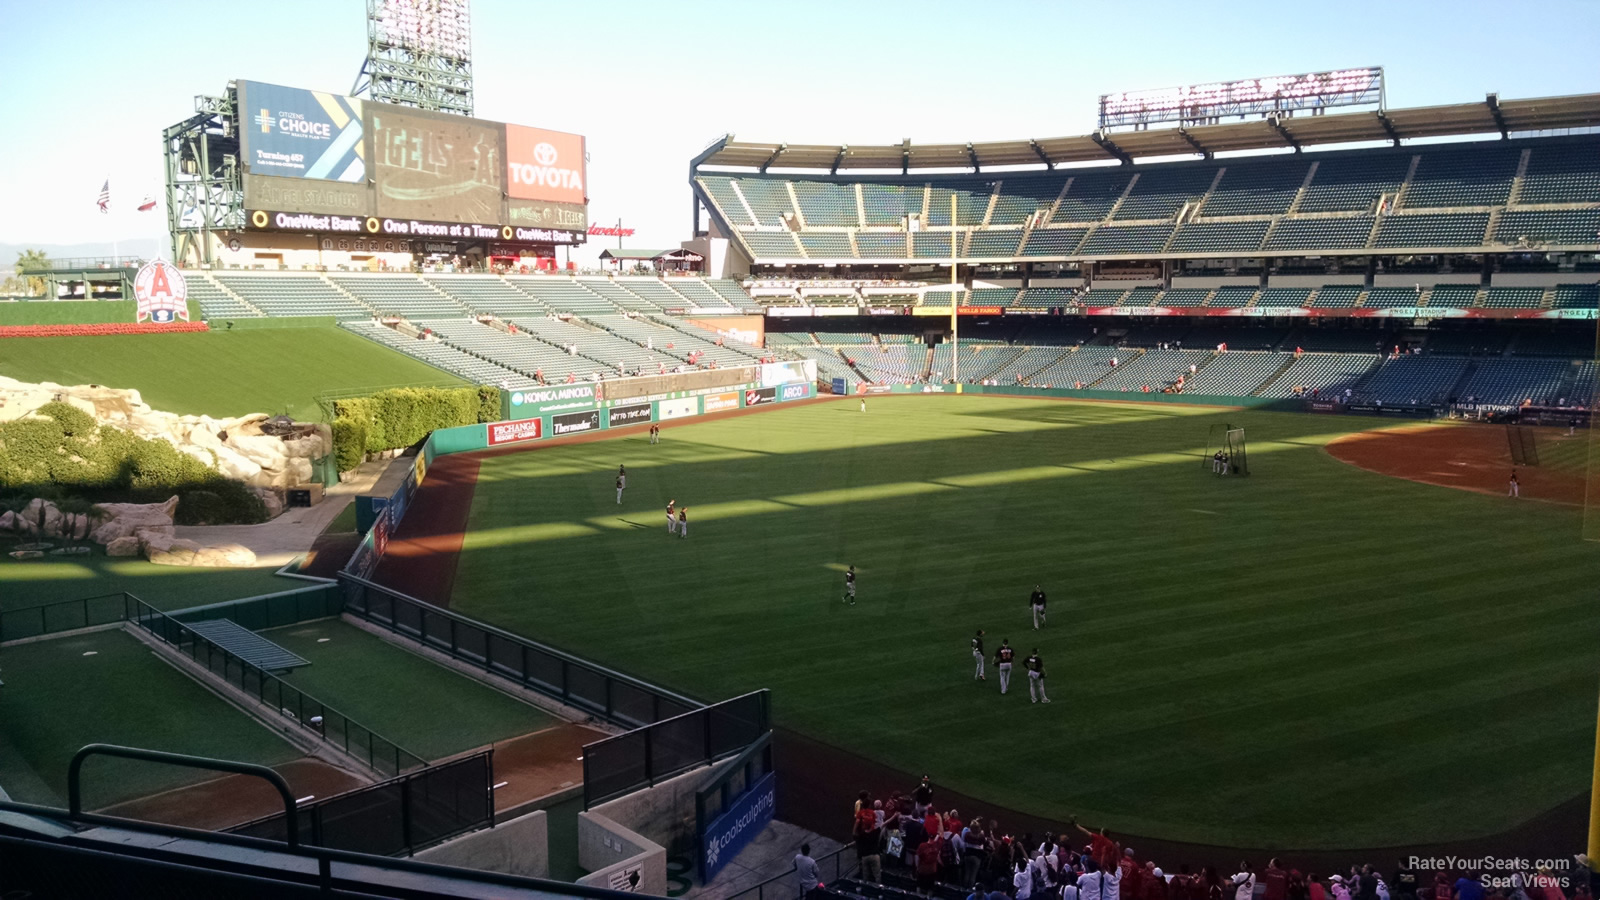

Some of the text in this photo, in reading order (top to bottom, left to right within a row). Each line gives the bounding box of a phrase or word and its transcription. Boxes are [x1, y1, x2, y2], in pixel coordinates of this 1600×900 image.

[279, 111, 305, 120] CITIZENS
[279, 118, 331, 137] CHOICE
[256, 149, 290, 162] Turning
[509, 162, 583, 190] TOYOTA
[275, 212, 361, 231] OneWest Bank
[383, 219, 497, 238] One Person at a Time
[515, 227, 553, 241] OneWest
[552, 230, 574, 242] Bank
[150, 259, 173, 297] A
[524, 388, 557, 404] KONICA
[558, 386, 593, 400] MINOLTA
[783, 386, 802, 399] ARCO
[1475, 404, 1518, 412] NETWORK
[610, 411, 626, 421] NITTO
[494, 421, 536, 435] PECHANGA
[554, 420, 591, 434] Thermador
[494, 430, 536, 441] RESORT CASINO
[720, 791, 773, 848] coolsculpting
